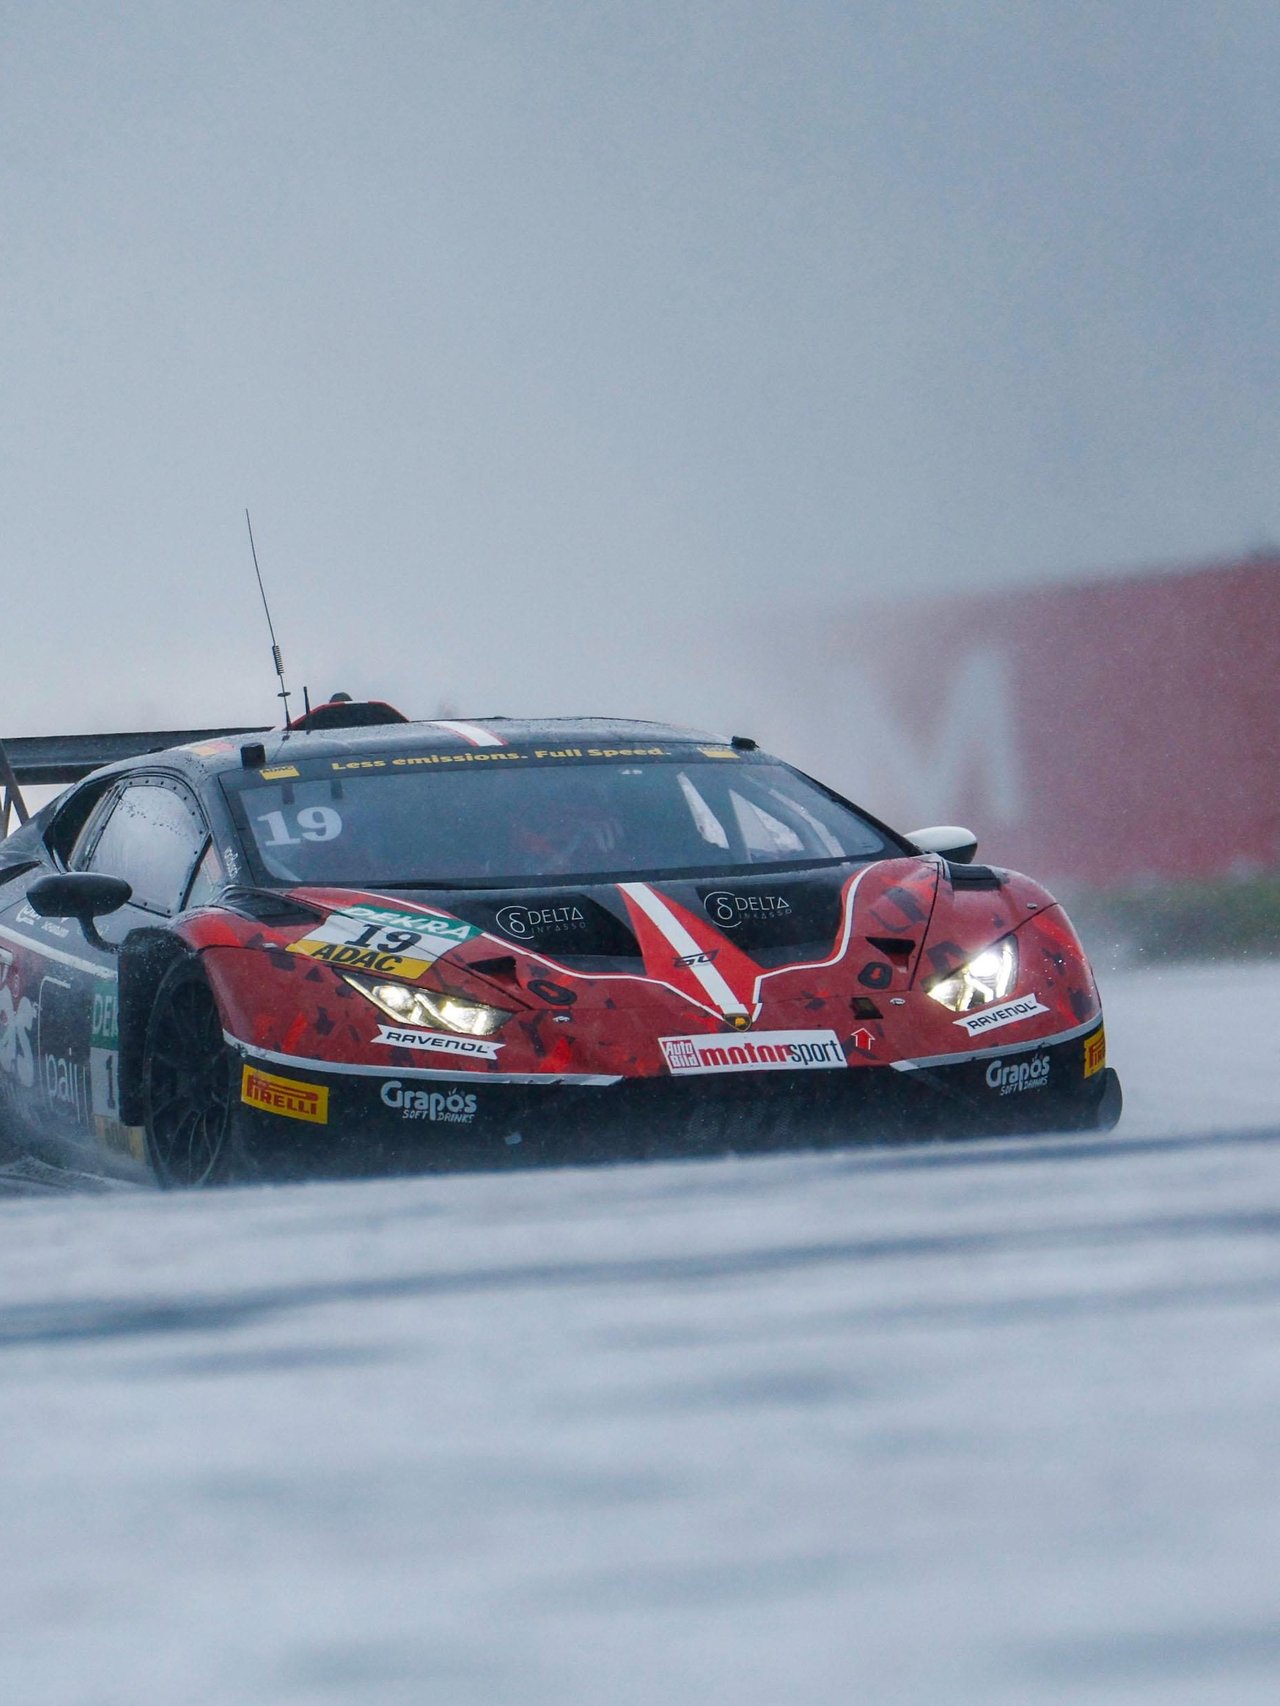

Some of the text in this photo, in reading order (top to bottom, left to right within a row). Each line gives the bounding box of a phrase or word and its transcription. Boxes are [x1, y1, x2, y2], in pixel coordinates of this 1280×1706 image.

[331, 761, 386, 771] Less
[391, 752, 528, 766] emissions.
[535, 748, 582, 759] Full
[257, 806, 343, 846] 19
[527, 907, 584, 925] DELTA
[735, 896, 790, 911] DELTA
[341, 906, 471, 940] DEKRA
[344, 923, 423, 953] 19
[311, 944, 404, 972] ADAC
[92, 993, 119, 1038] DEK
[967, 1001, 1038, 1030] RAVENOL
[386, 1031, 489, 1054] RAVENOL
[665, 1041, 694, 1056] Auto
[246, 1074, 319, 1115] PIRELLI
[402, 1109, 428, 1119] SOFT
